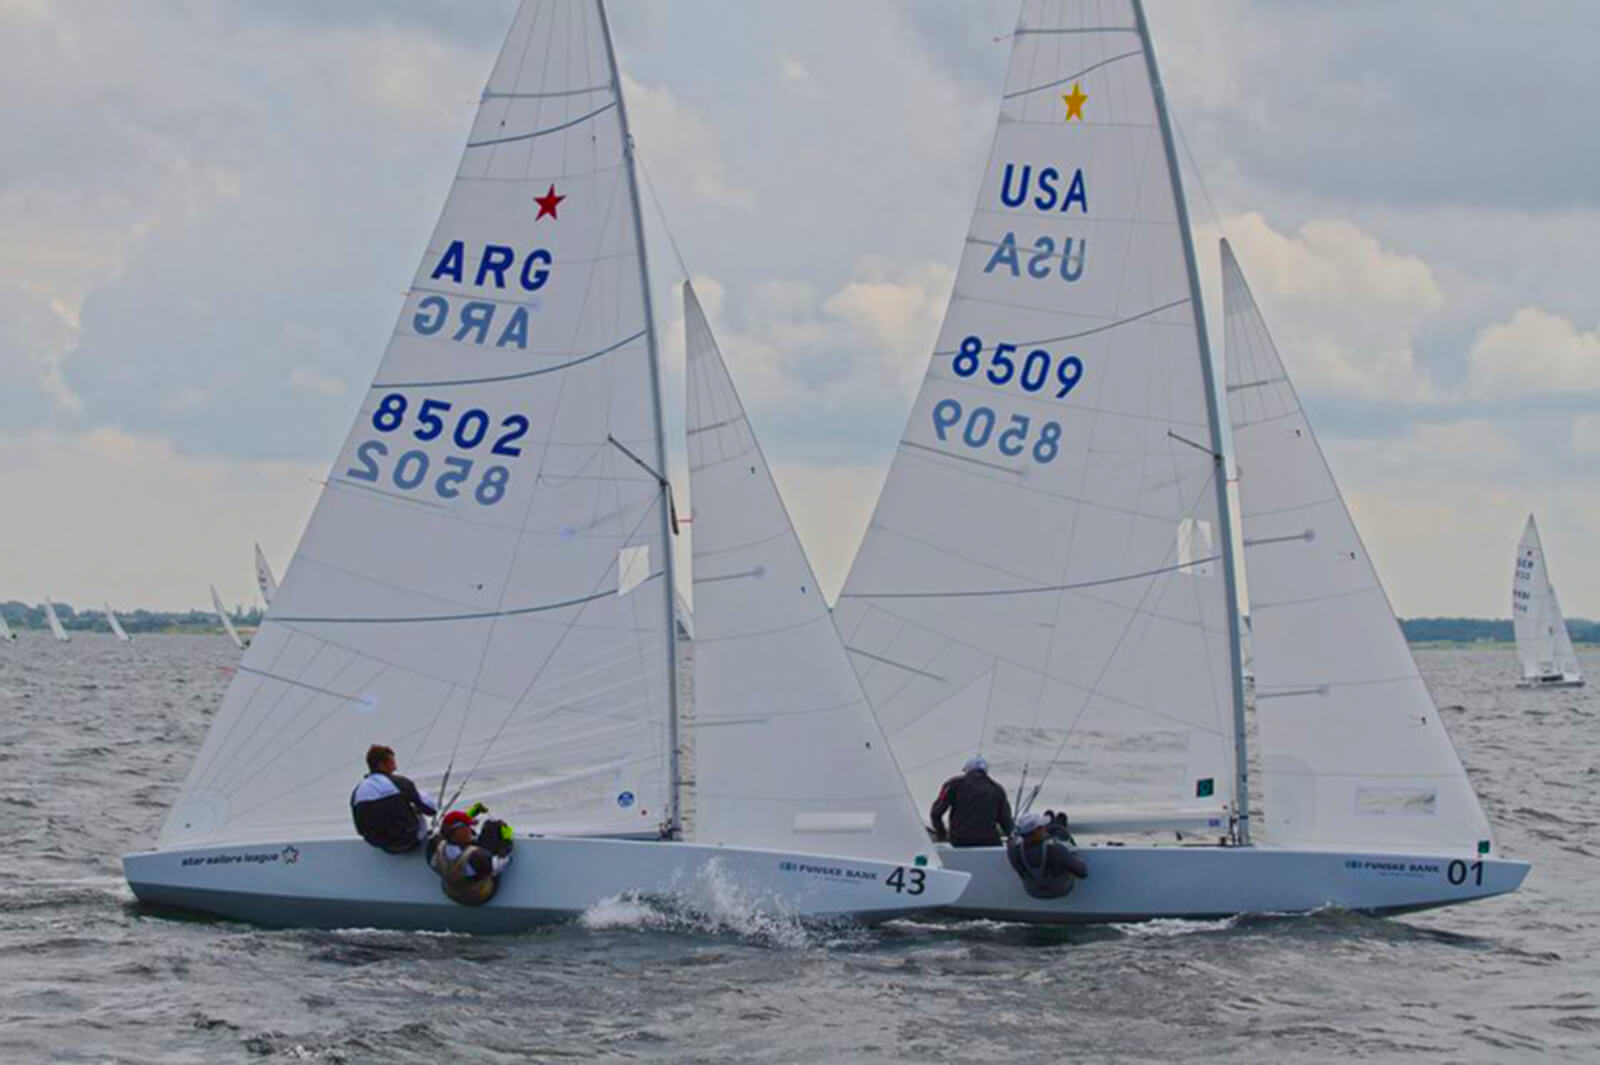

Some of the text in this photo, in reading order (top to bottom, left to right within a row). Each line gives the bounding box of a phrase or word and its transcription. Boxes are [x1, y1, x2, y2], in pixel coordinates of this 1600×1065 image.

[1000, 163, 1088, 213] USA
[431, 240, 553, 291] ARG
[952, 335, 1083, 399] 8509
[372, 393, 529, 457] 8502
[244, 852, 279, 864] league
[1408, 863, 1440, 873] BANK
[1447, 859, 1484, 886] 01
[846, 869, 878, 881] BANK
[885, 866, 926, 895] 43
